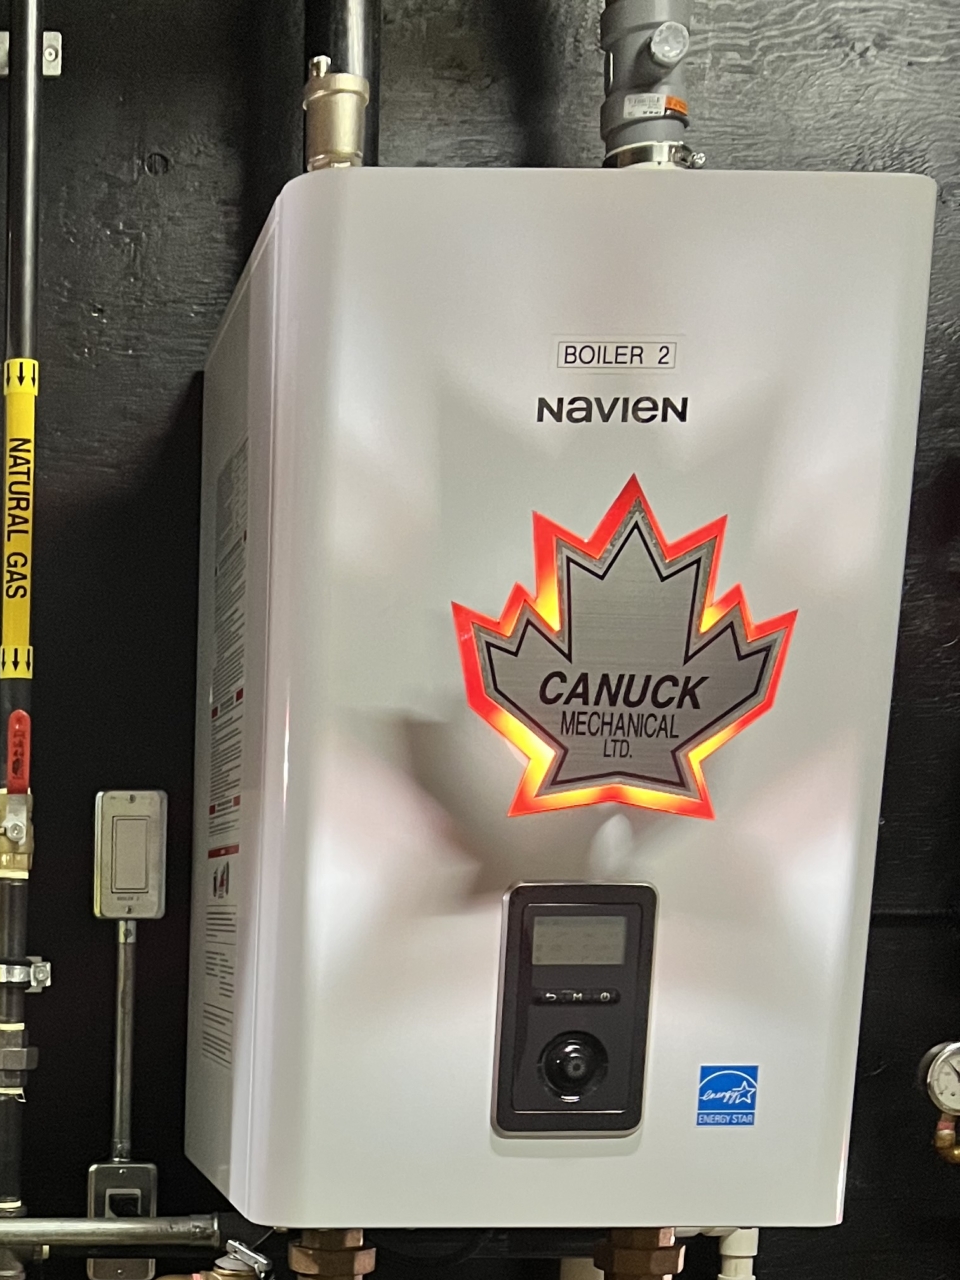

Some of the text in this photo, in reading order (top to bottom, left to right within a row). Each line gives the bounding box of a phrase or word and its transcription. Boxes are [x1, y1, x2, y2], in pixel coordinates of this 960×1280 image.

[563, 345, 671, 365] BOILER 2
[5, 437, 32, 599] NATURAL GAS
[538, 670, 711, 710] CANUCK
[559, 710, 680, 740] MECHANICAL
[602, 738, 633, 759] LTD.
[572, 992, 583, 1002] M
[698, 1114, 753, 1124] ENERGY STAR
